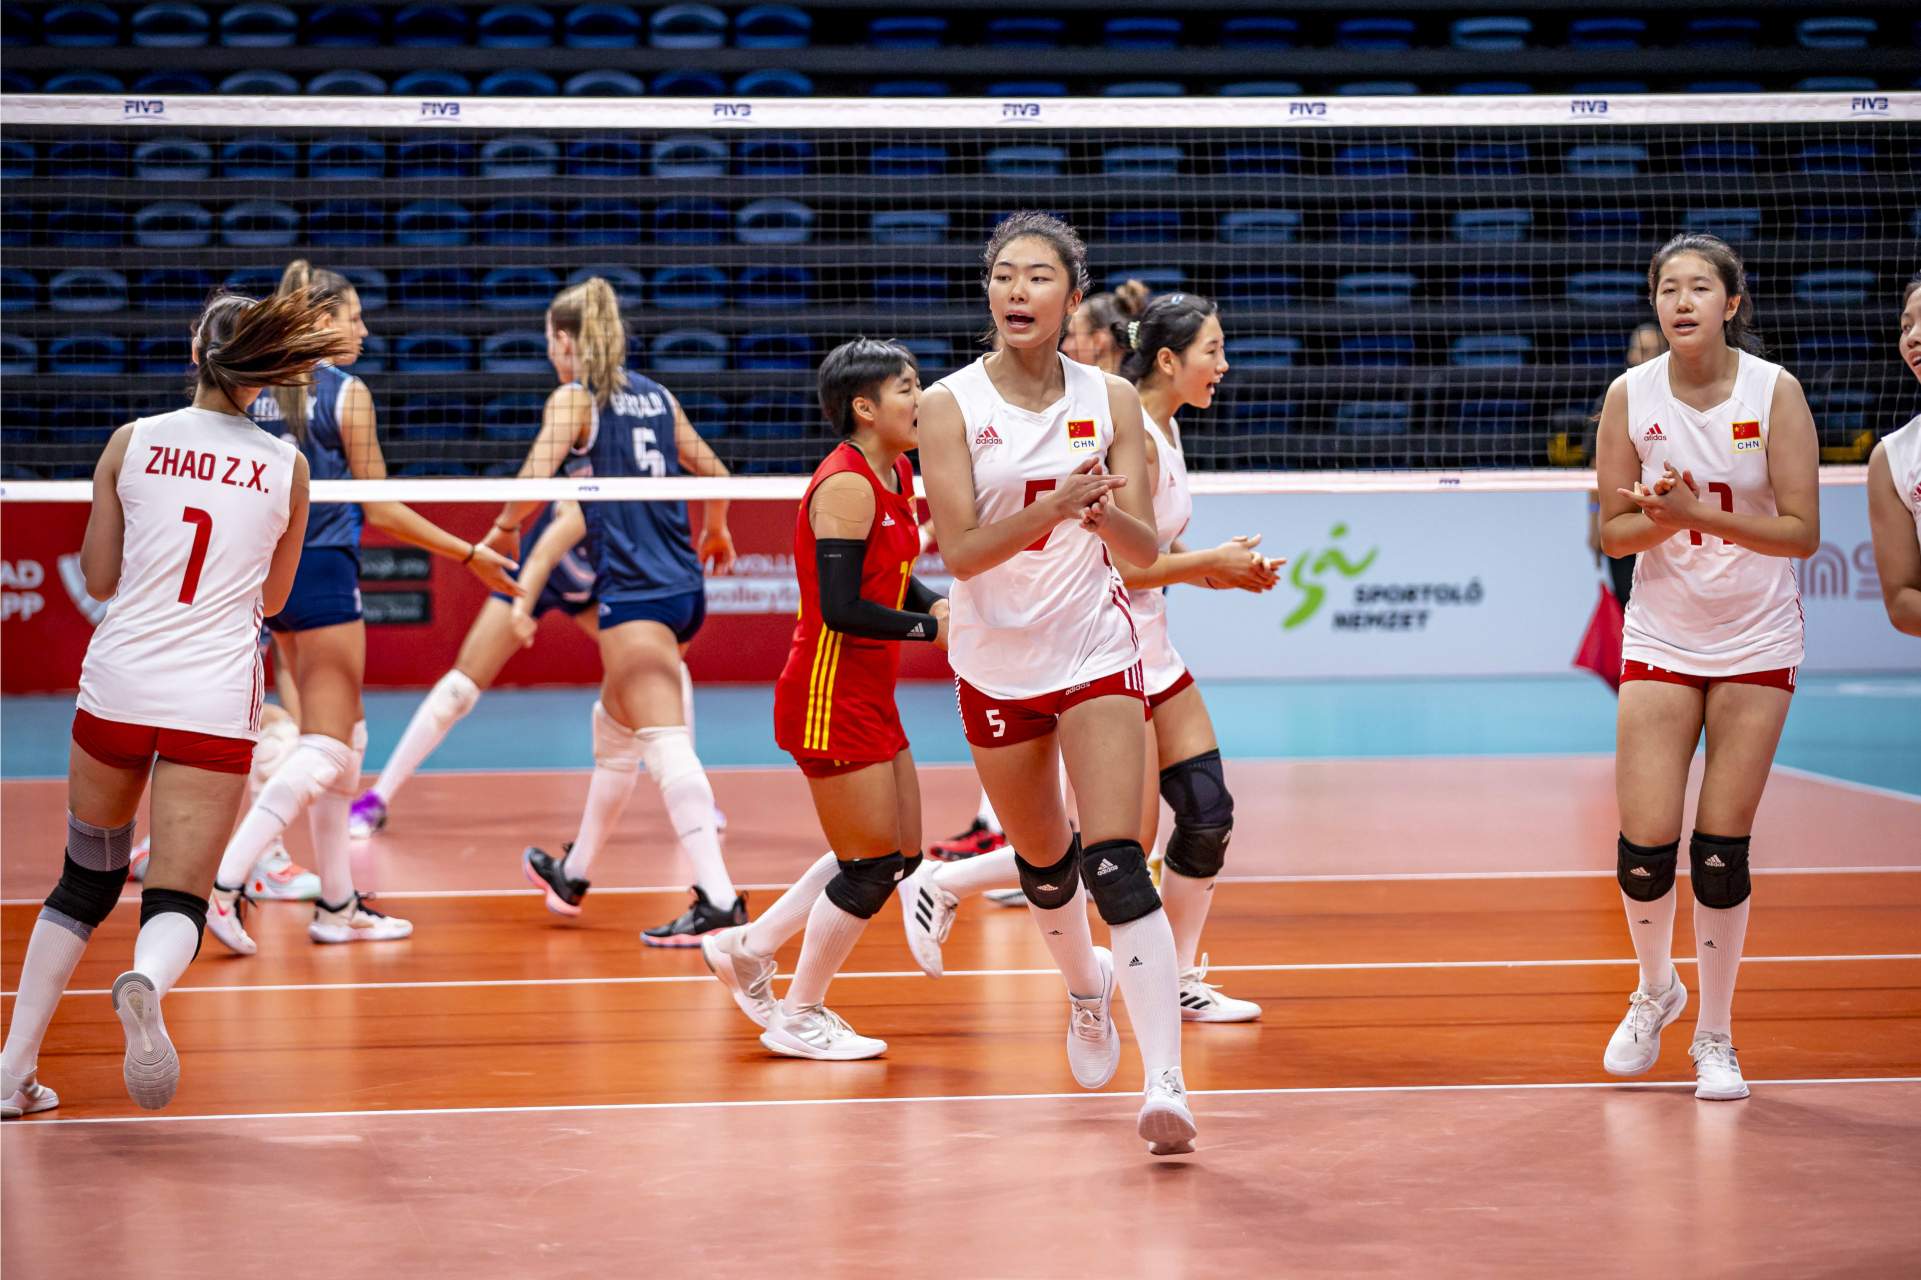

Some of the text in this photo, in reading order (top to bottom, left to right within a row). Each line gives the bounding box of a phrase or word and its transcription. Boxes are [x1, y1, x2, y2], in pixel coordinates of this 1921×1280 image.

[976, 437, 1003, 445] adidas
[1073, 440, 1095, 449] CHN
[1737, 440, 1760, 450] CHN
[145, 446, 269, 494] ZHAO Z.X.
[1354, 576, 1484, 605] SPORTOLÓ
[1332, 610, 1429, 631] NEMZET
[986, 709, 1005, 737] 5
